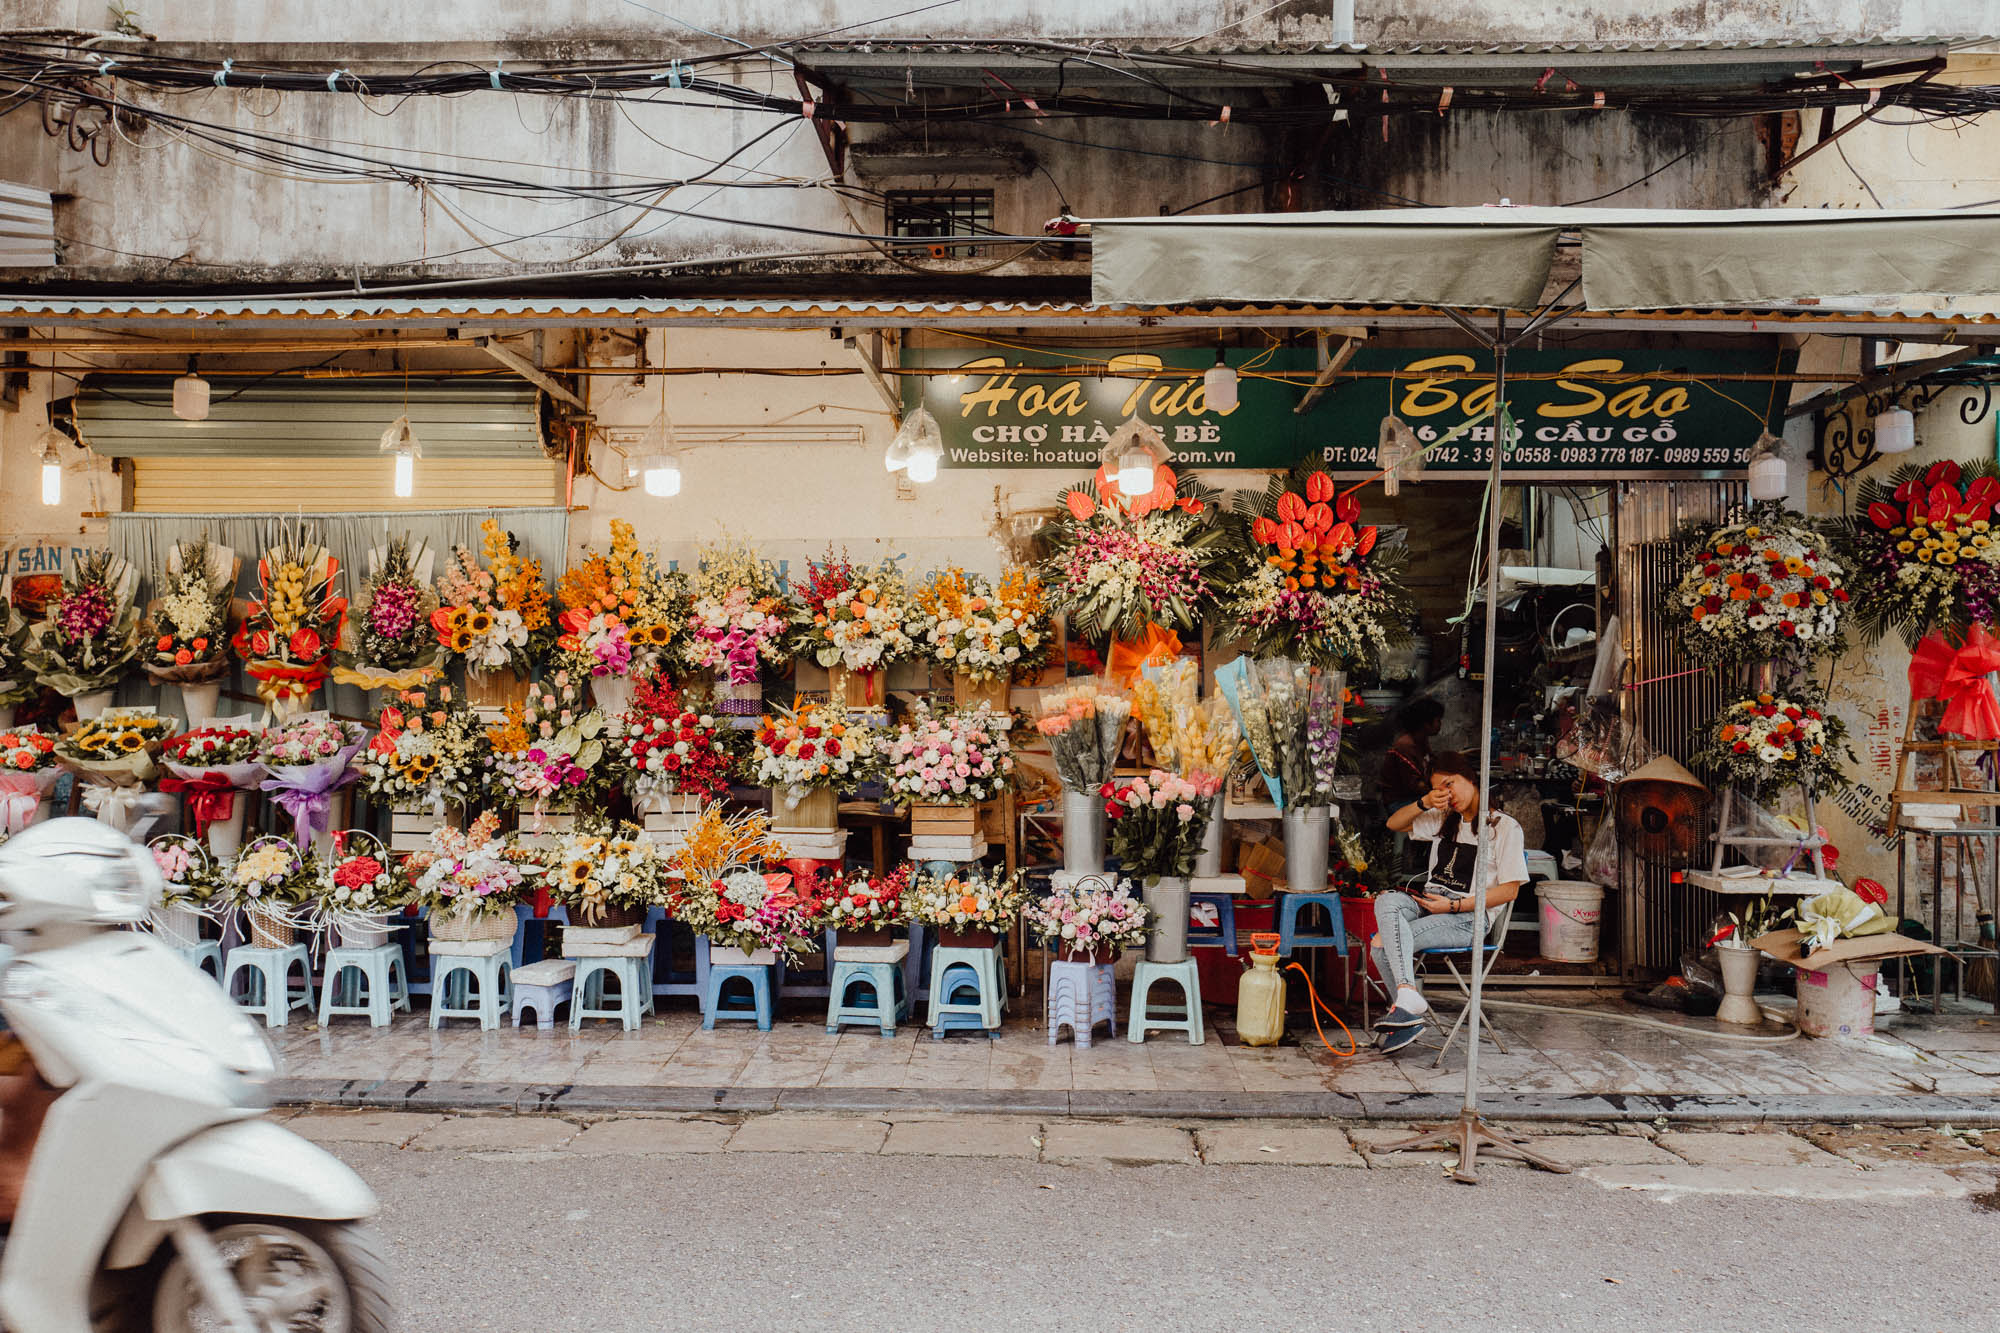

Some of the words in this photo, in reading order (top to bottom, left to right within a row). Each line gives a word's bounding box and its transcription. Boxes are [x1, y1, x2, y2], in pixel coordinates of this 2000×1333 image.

[959, 356, 1088, 417] Hoa
[1537, 358, 1691, 419] Sao
[972, 423, 1048, 447] CHỢ
[1174, 417, 1221, 443] BÈ
[1535, 420, 1614, 442] CẦU
[1622, 419, 1678, 443] GỖ
[949, 447, 1029, 463] Website:
[1322, 446, 1347, 463] ĐT:
[1350, 446, 1377, 463] 024
[1484, 447, 1512, 463] 96
[1515, 446, 1551, 463] 0558
[1560, 446, 1597, 463] 0983
[1600, 446, 1626, 463] 778
[1664, 446, 1700, 464] 0989
[1702, 446, 1729, 464] 559
[1733, 447, 1750, 464] 50
